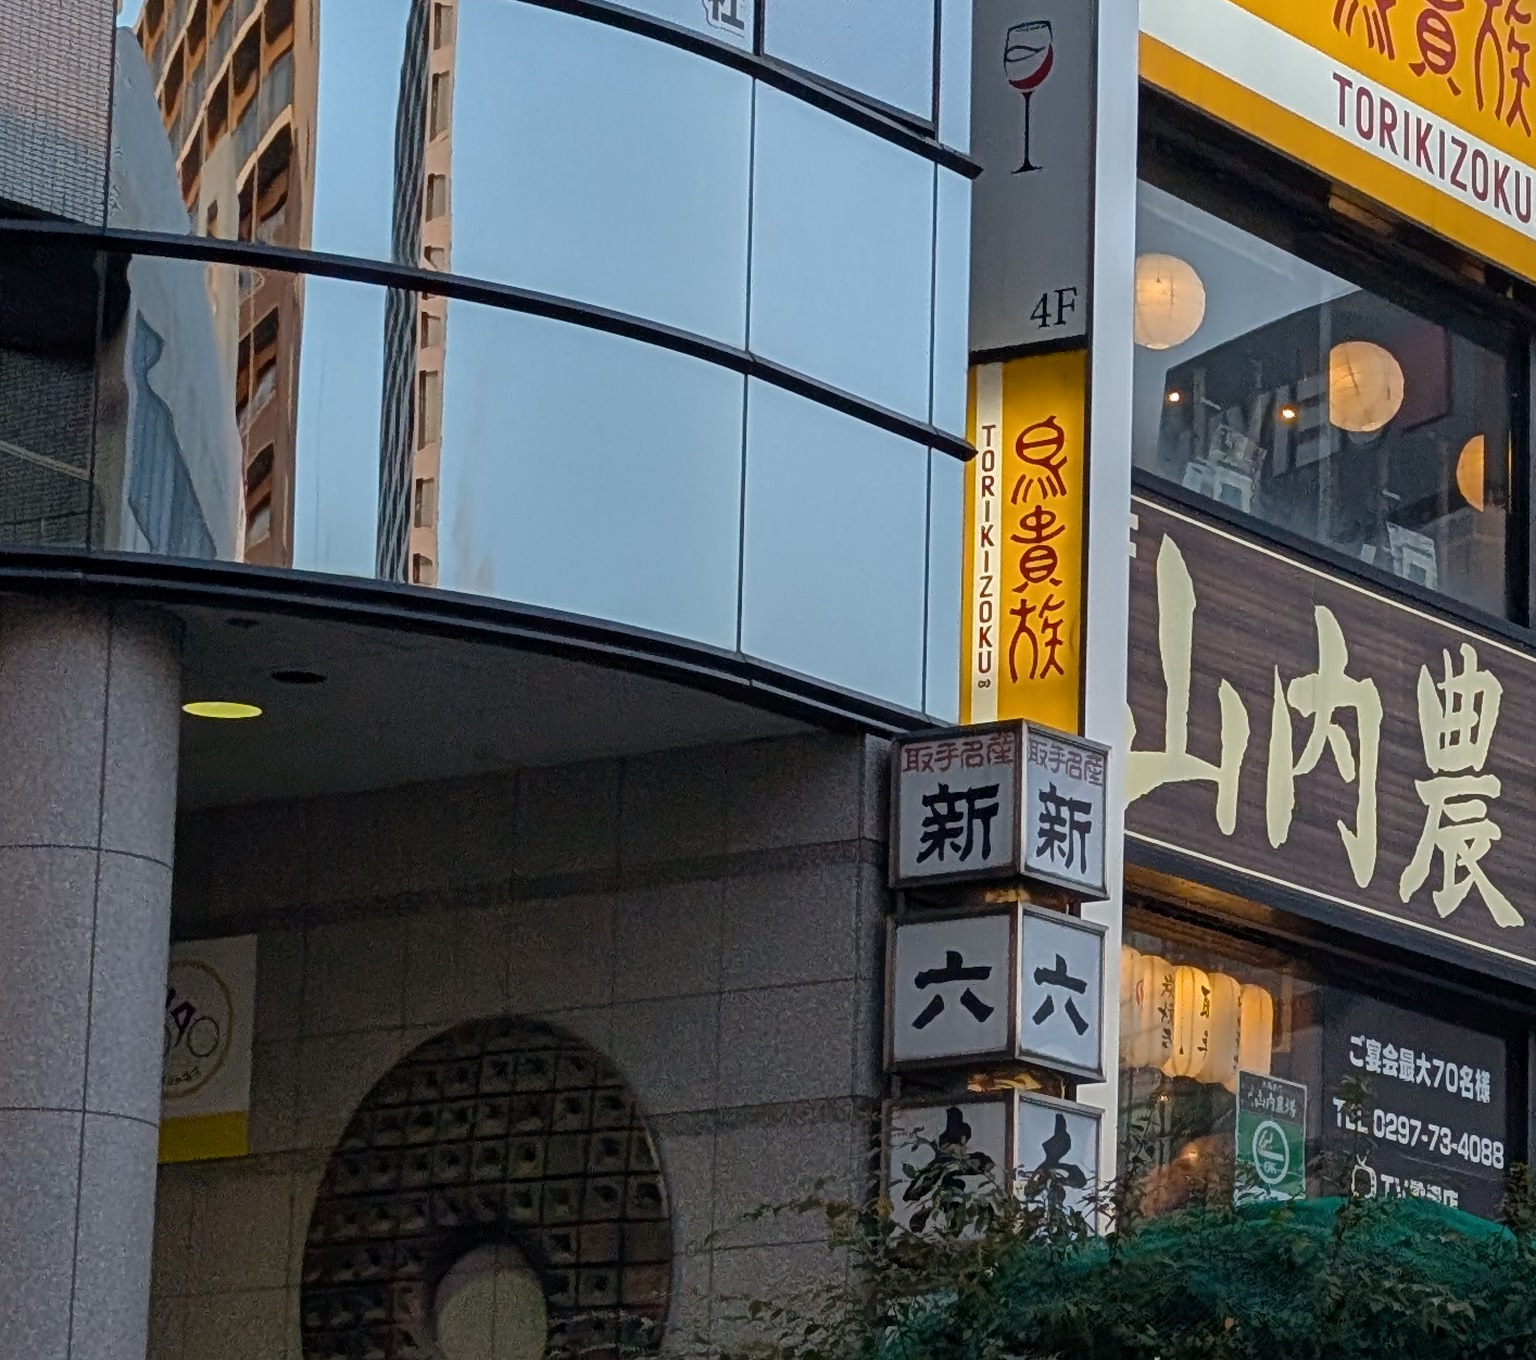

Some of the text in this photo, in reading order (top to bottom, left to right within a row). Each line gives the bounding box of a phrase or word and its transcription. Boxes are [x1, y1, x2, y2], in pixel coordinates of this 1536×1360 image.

[1332, 71, 1533, 224] TORIKIZOKU
[1029, 287, 1079, 328] 4F
[977, 423, 998, 674] TORIKIZOKU
[902, 731, 1014, 773] 取手名産
[1028, 740, 1104, 787] 取手名産
[1350, 1035, 1491, 1104] ご宴会最大70名様
[1373, 1108, 1505, 1170] 0297-73-4088
